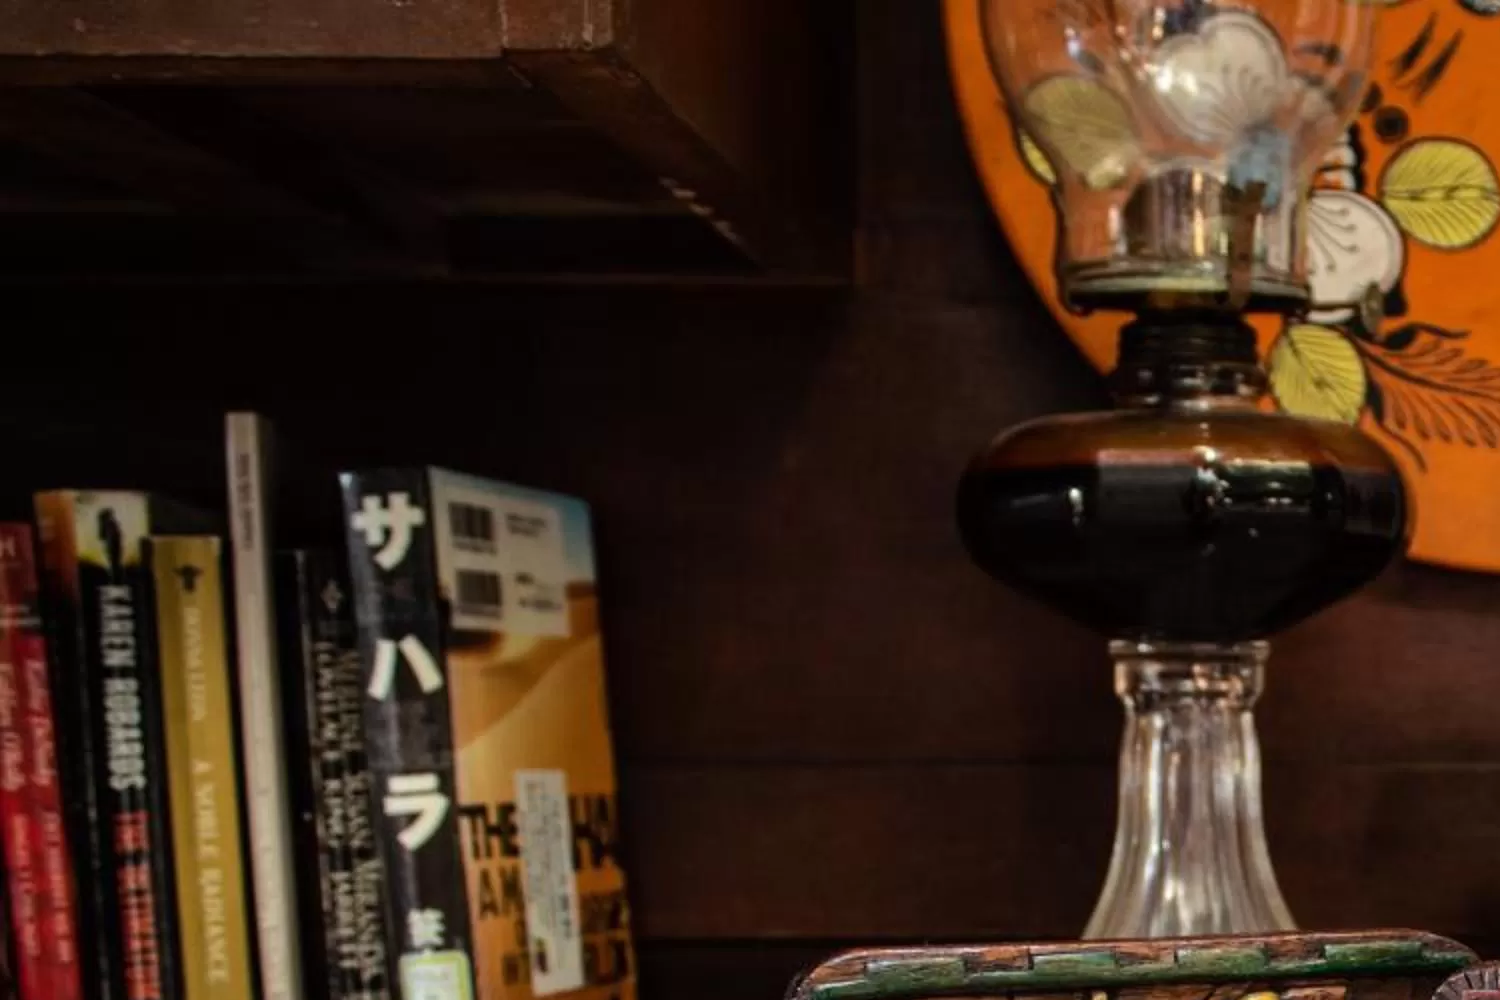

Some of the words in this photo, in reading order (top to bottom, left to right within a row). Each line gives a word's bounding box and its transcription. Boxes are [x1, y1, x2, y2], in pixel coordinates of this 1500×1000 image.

[99, 584, 137, 667] KAREN
[352, 491, 449, 851] サハラ
[103, 677, 147, 790] ROBARDS
